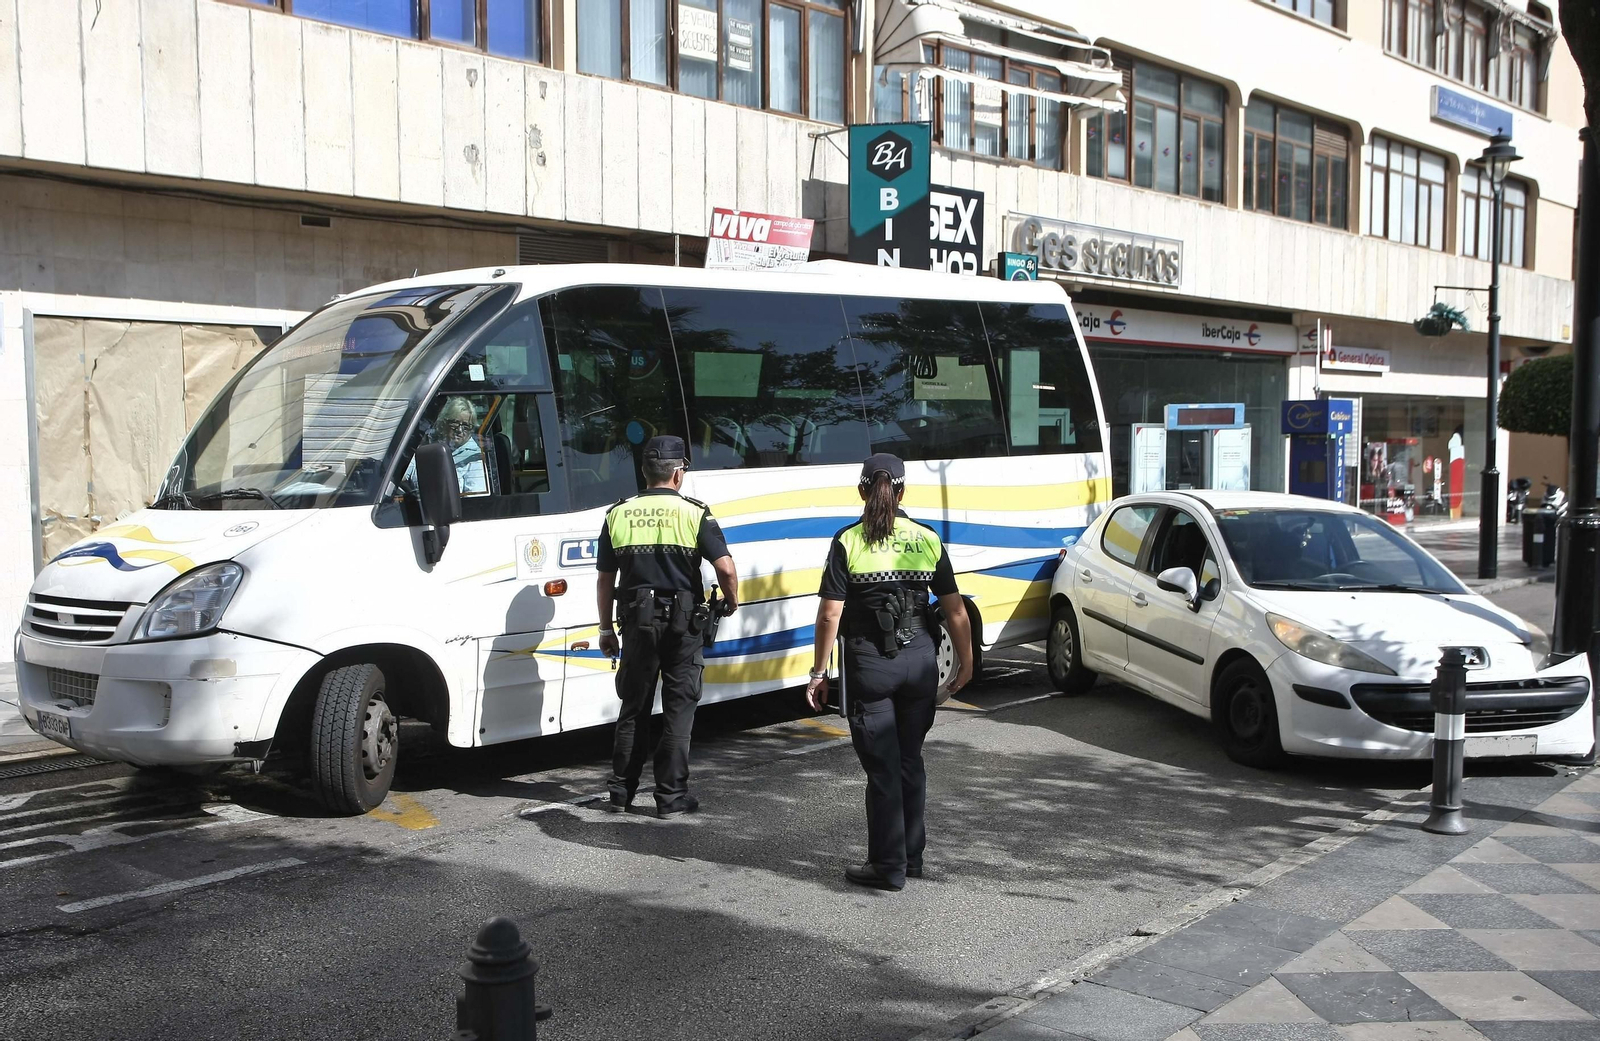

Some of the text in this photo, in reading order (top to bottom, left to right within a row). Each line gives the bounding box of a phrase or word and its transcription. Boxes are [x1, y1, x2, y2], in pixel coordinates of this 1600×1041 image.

[871, 141, 908, 171] BA
[1007, 257, 1026, 267] BINGO
[1201, 322, 1241, 344] iberCaja
[1338, 351, 1363, 364] General
[624, 508, 678, 519] POLICIA
[629, 518, 673, 529] LOCAL
[870, 541, 923, 554] LOCAL
